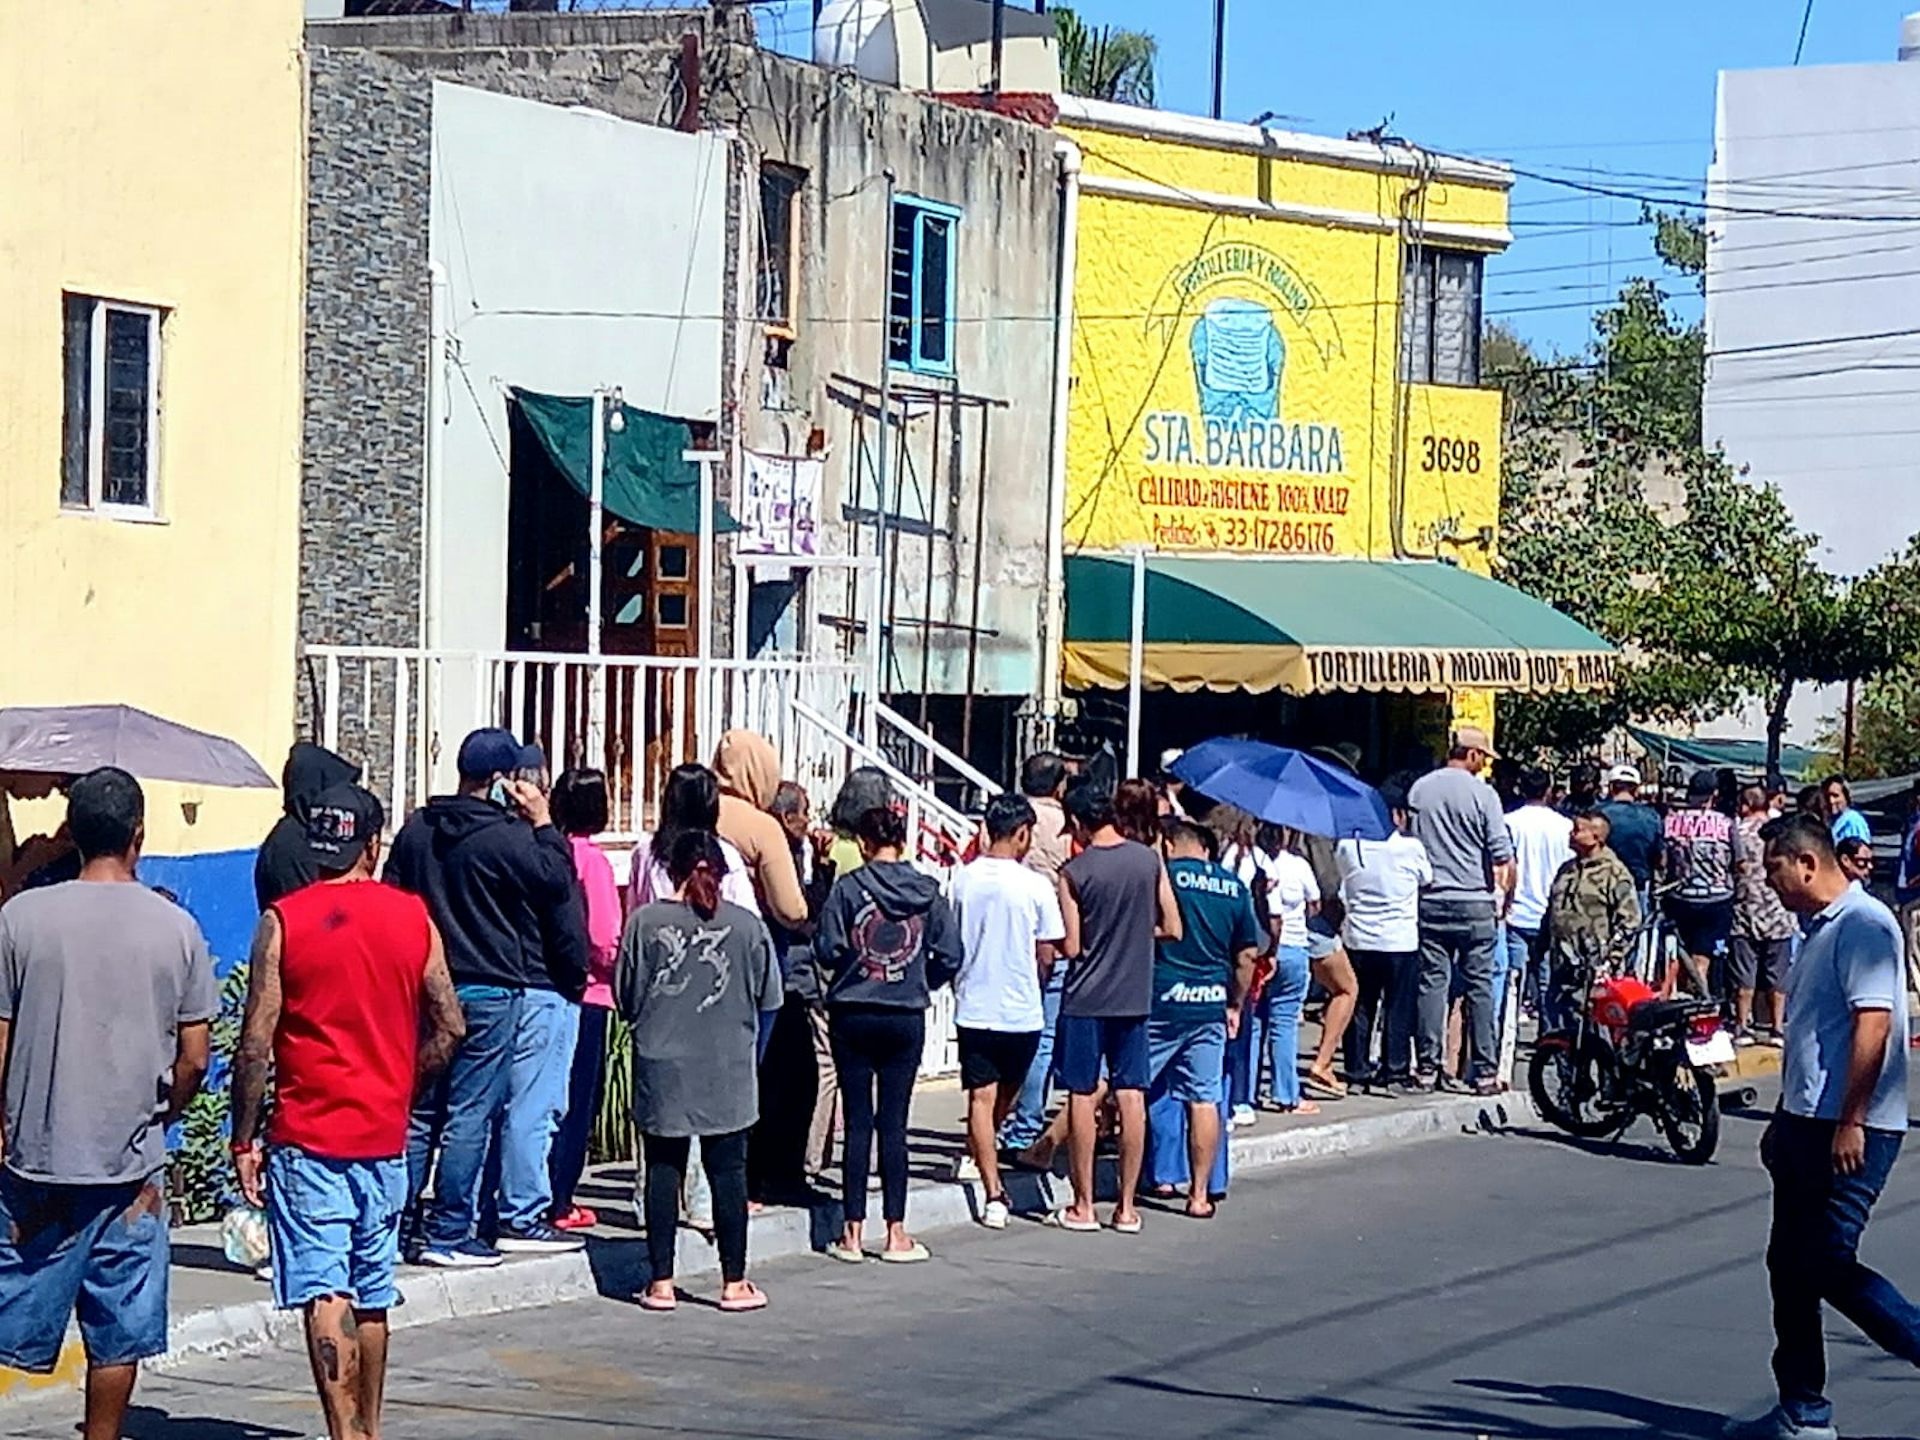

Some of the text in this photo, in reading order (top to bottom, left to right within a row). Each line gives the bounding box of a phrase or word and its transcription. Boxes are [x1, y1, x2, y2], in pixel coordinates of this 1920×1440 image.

[1257, 252, 1268, 277] Y
[1145, 413, 1343, 474] STA. BARBARA
[1421, 435, 1480, 474] 3698
[1138, 475, 1201, 507] CALIDAD
[1210, 479, 1270, 512] HIGIENE
[1313, 485, 1350, 516] MAIZ
[1306, 651, 1431, 685] TORTILLERIA
[1433, 652, 1445, 683] Y
[1449, 652, 1521, 683] MOLINO
[1526, 655, 1574, 688] 100%
